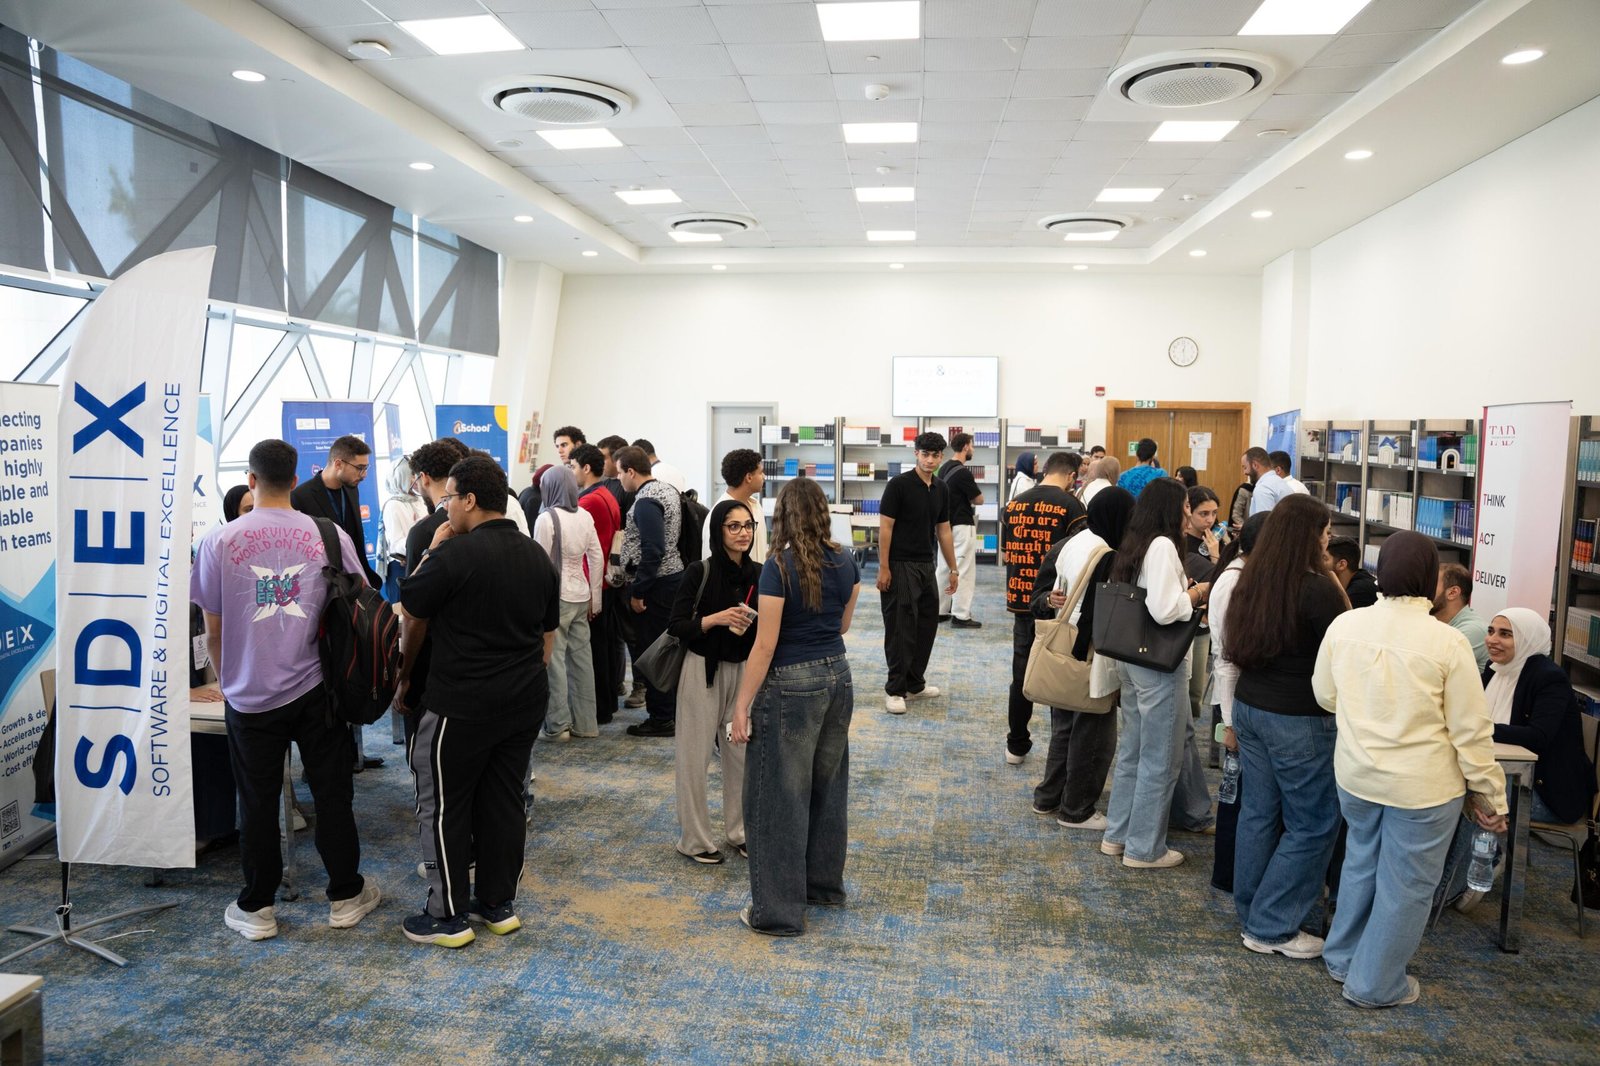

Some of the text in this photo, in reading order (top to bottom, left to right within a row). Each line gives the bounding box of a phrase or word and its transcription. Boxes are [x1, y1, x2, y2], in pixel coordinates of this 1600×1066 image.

[0, 411, 41, 429] ecting
[4, 458, 43, 478] highly
[30, 481, 49, 498] and
[1007, 500, 1067, 516] For those
[1483, 493, 1506, 508] THINK
[1009, 513, 1058, 527] who are
[11, 531, 52, 549] teams
[228, 539, 240, 553] I
[244, 527, 312, 544] SURVIVED
[1013, 525, 1051, 542] Crazy
[1479, 532, 1495, 546] ACT
[231, 539, 322, 565] WORLD ON FIRE
[1475, 570, 1506, 588] DELIVER
[150, 382, 181, 796] SOFTWARE & DIGITAL EXCELLENCE
[1, 709, 46, 735] Growth & de
